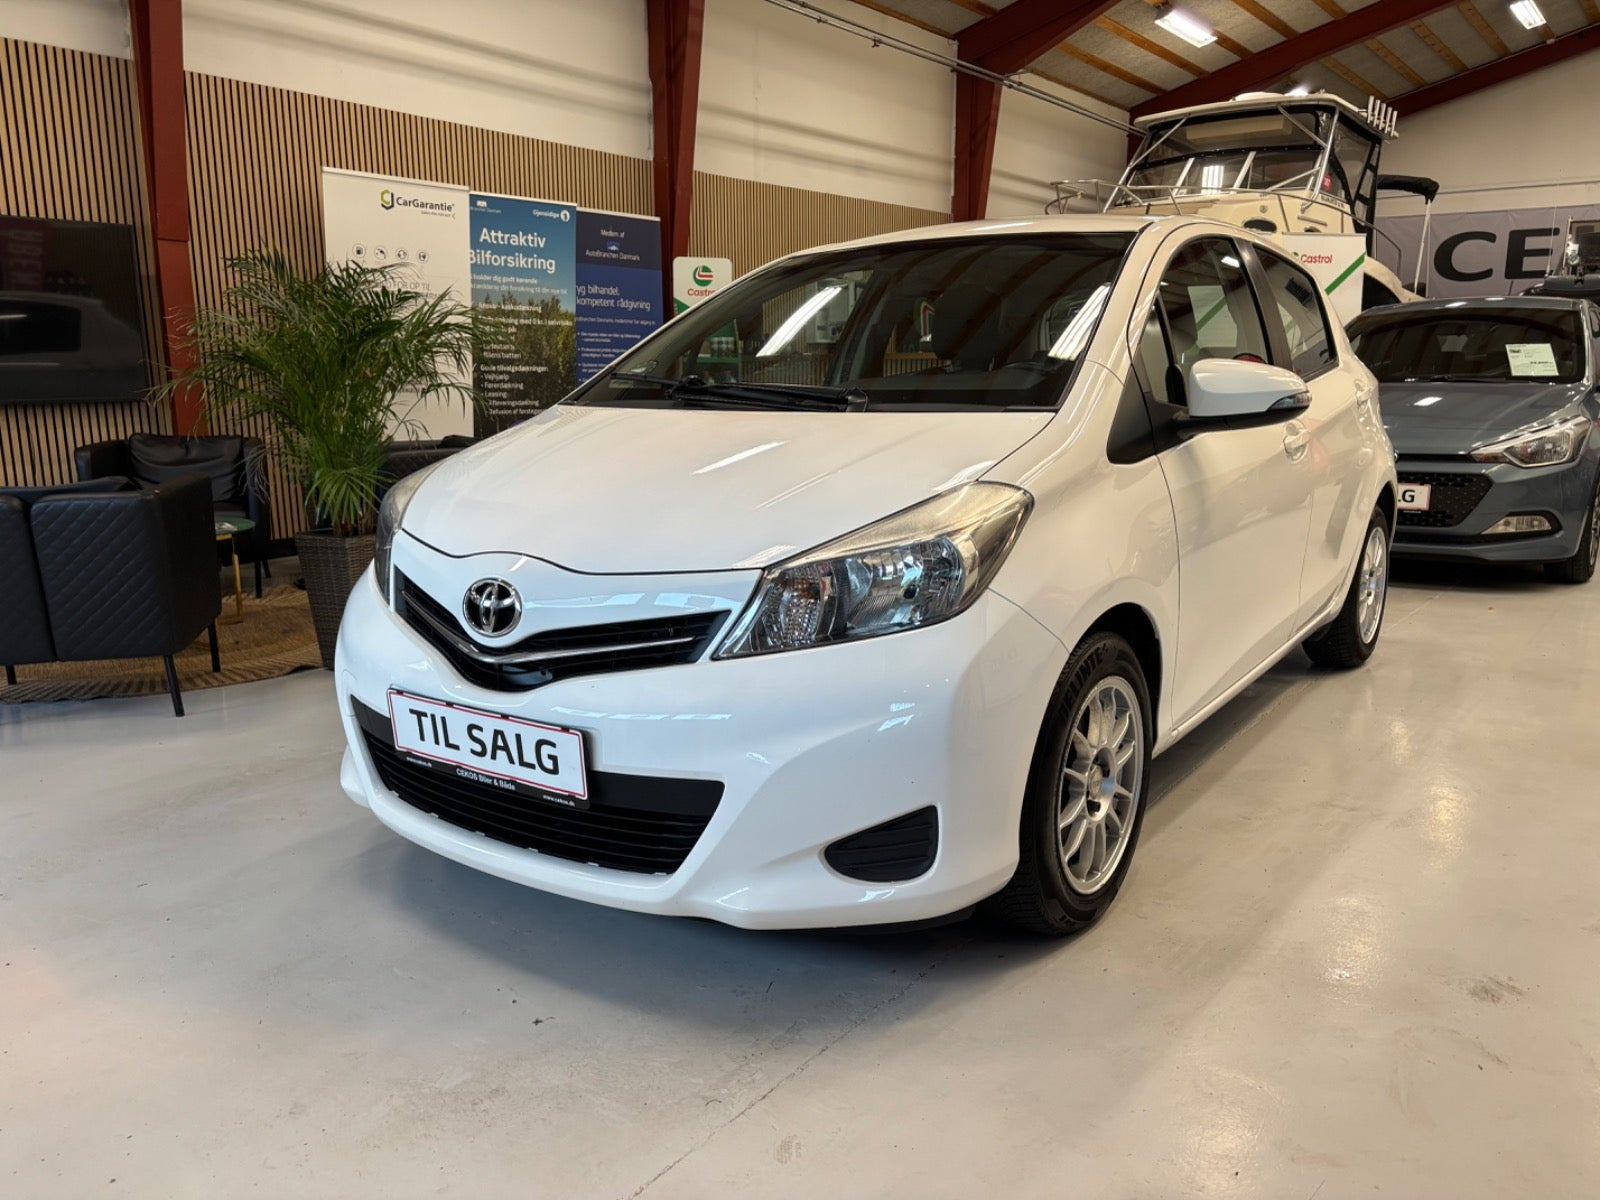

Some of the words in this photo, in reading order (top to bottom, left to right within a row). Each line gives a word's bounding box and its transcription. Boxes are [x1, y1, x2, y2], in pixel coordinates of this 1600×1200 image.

[396, 196, 453, 212] CarGarantie
[480, 227, 546, 248] Attraktiv
[1300, 254, 1333, 264] Castrol
[576, 285, 586, 296] yg
[688, 288, 716, 297] Castr
[577, 296, 615, 308] kompetent
[617, 298, 651, 312] rådgivning
[1398, 489, 1415, 503] G
[409, 708, 461, 751] TIL
[466, 723, 560, 775] SALG
